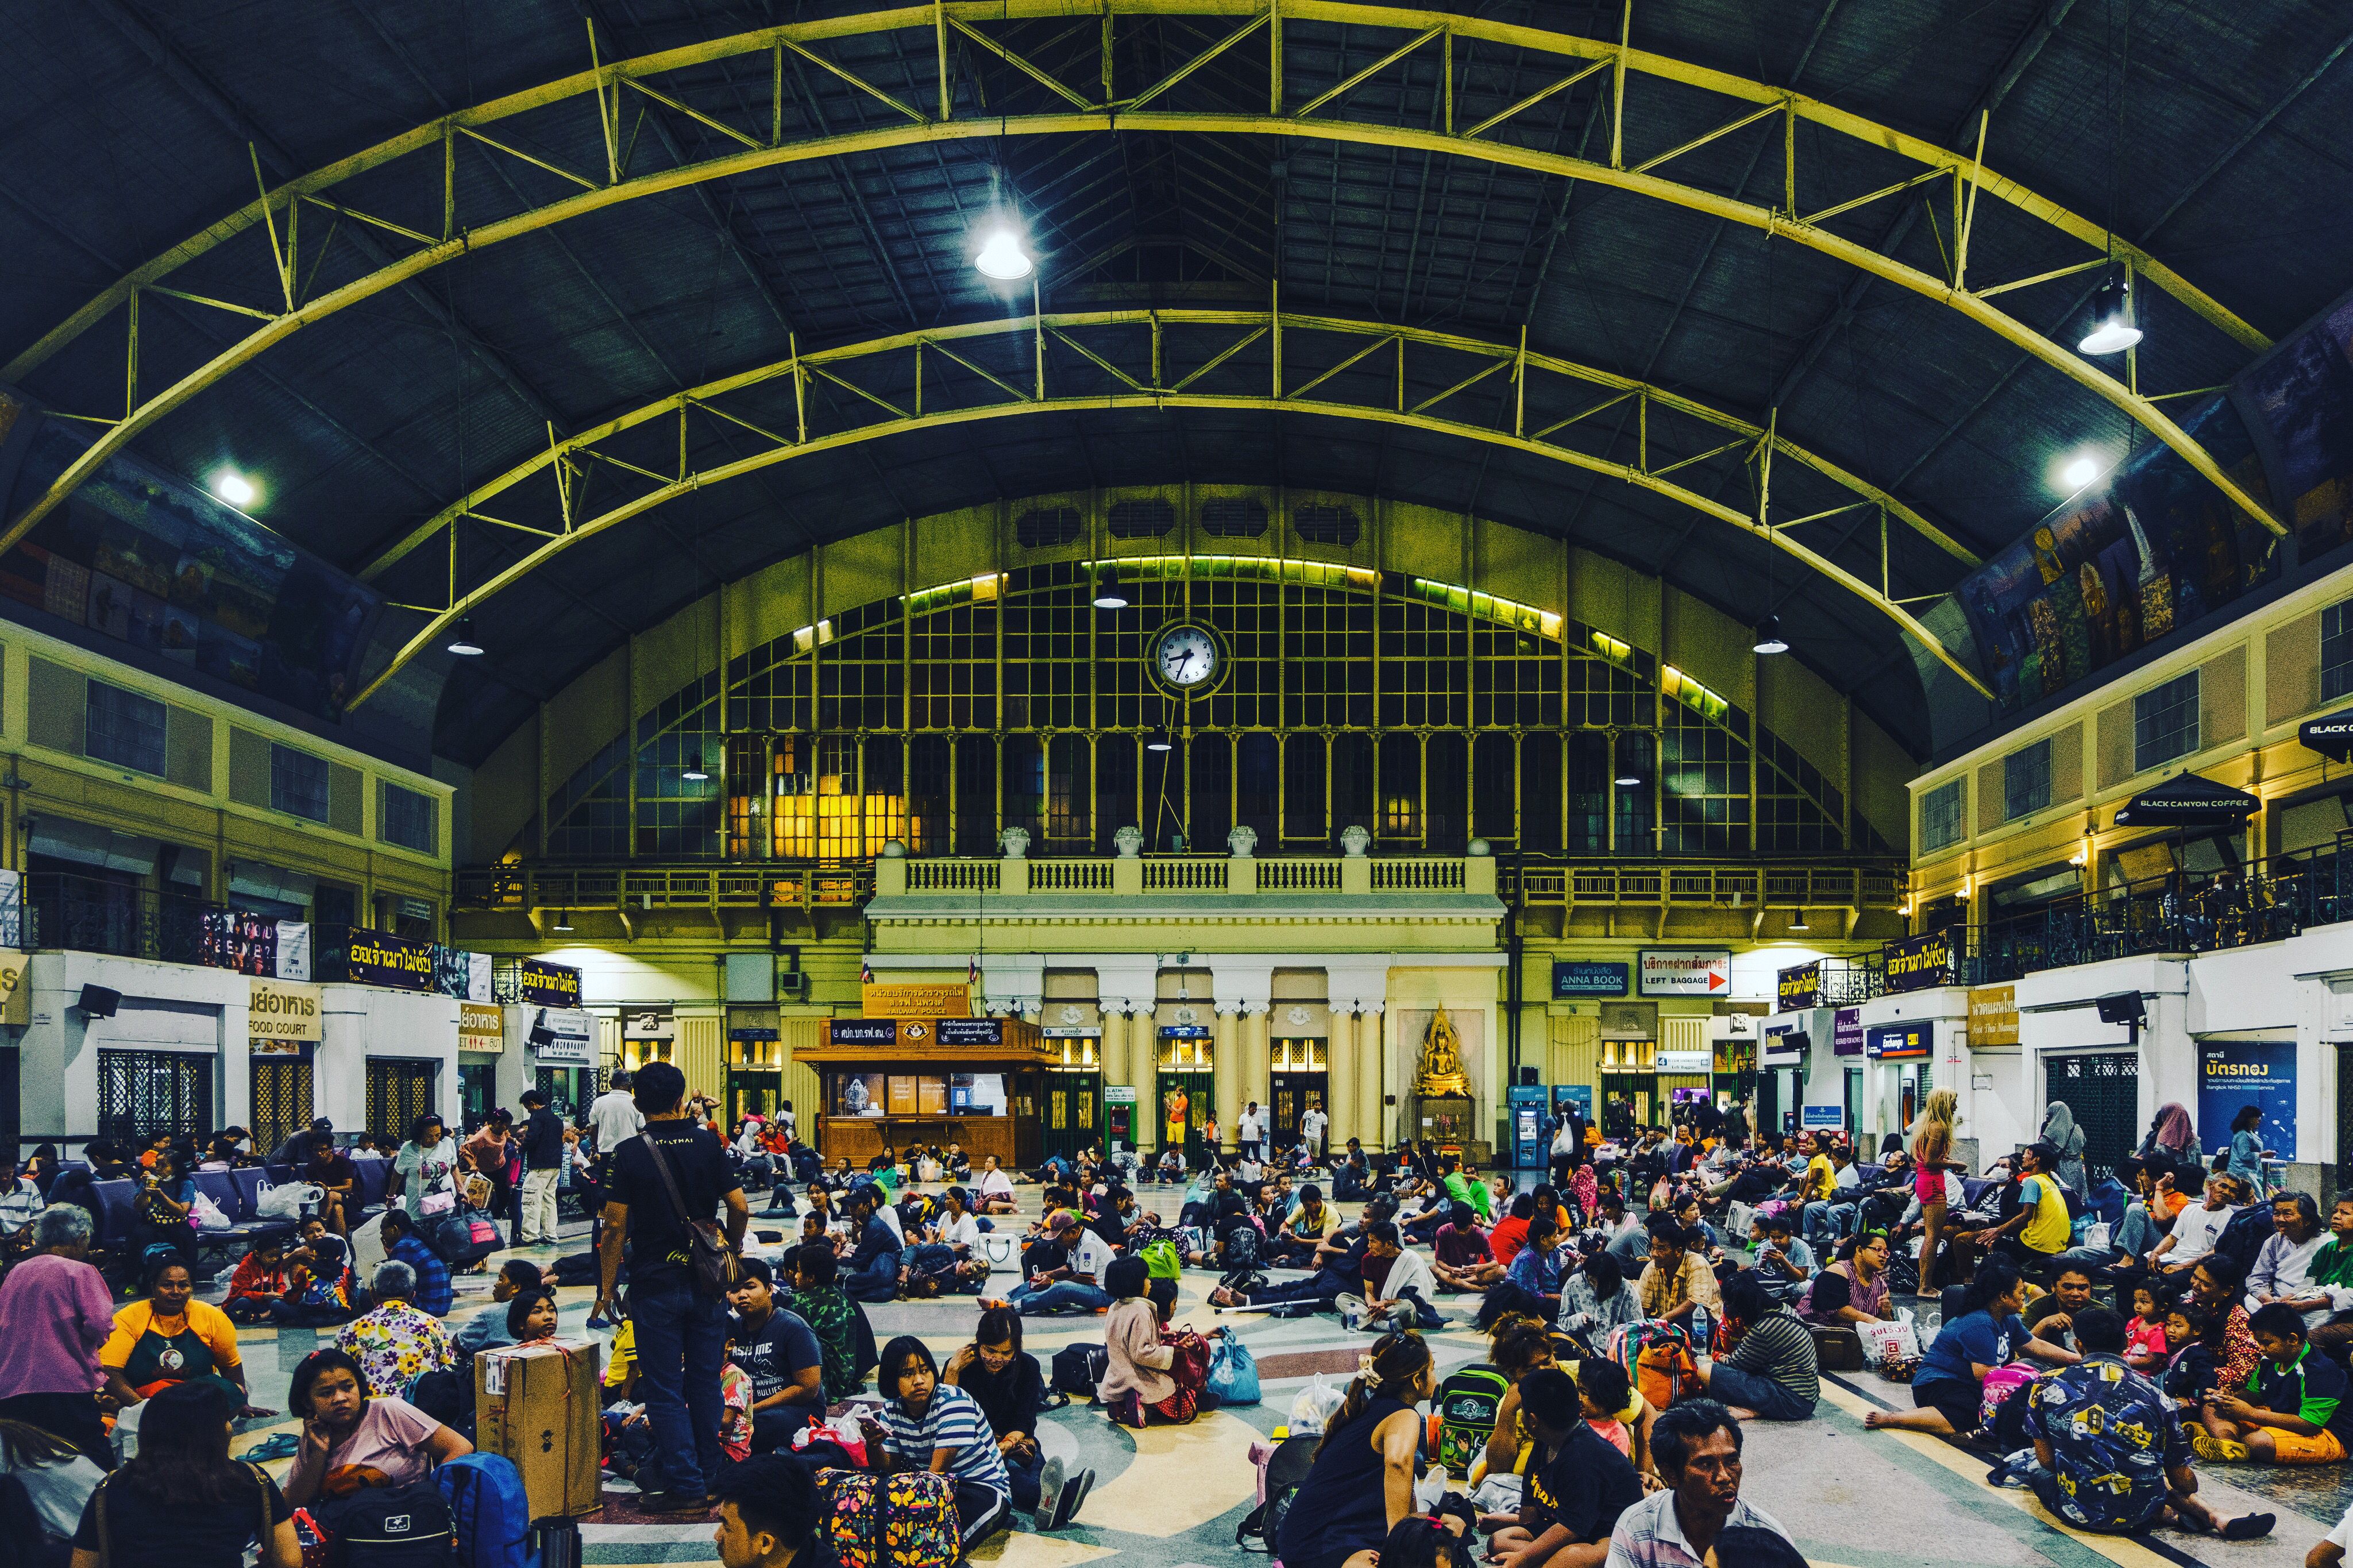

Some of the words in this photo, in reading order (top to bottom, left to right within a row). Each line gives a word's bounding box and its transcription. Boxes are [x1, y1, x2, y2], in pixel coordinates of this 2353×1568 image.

[2310, 725, 2347, 733] BLACK
[243, 922, 272, 940] YOU
[1644, 955, 1727, 970] บริการฝากสัมภาระ
[1561, 976, 1590, 984] ANNA
[1594, 976, 1623, 984] BOOK
[460, 1007, 499, 1030] ย์อาหาร
[276, 1022, 307, 1034] COURT
[1985, 1022, 1996, 1033] Thai
[1883, 1037, 1903, 1049] Exchange
[2207, 1059, 2269, 1076] บัตรทอง
[755, 1342, 773, 1355] ME
[755, 1377, 784, 1386] WARRIORS
[757, 1385, 782, 1397] BULLIES
